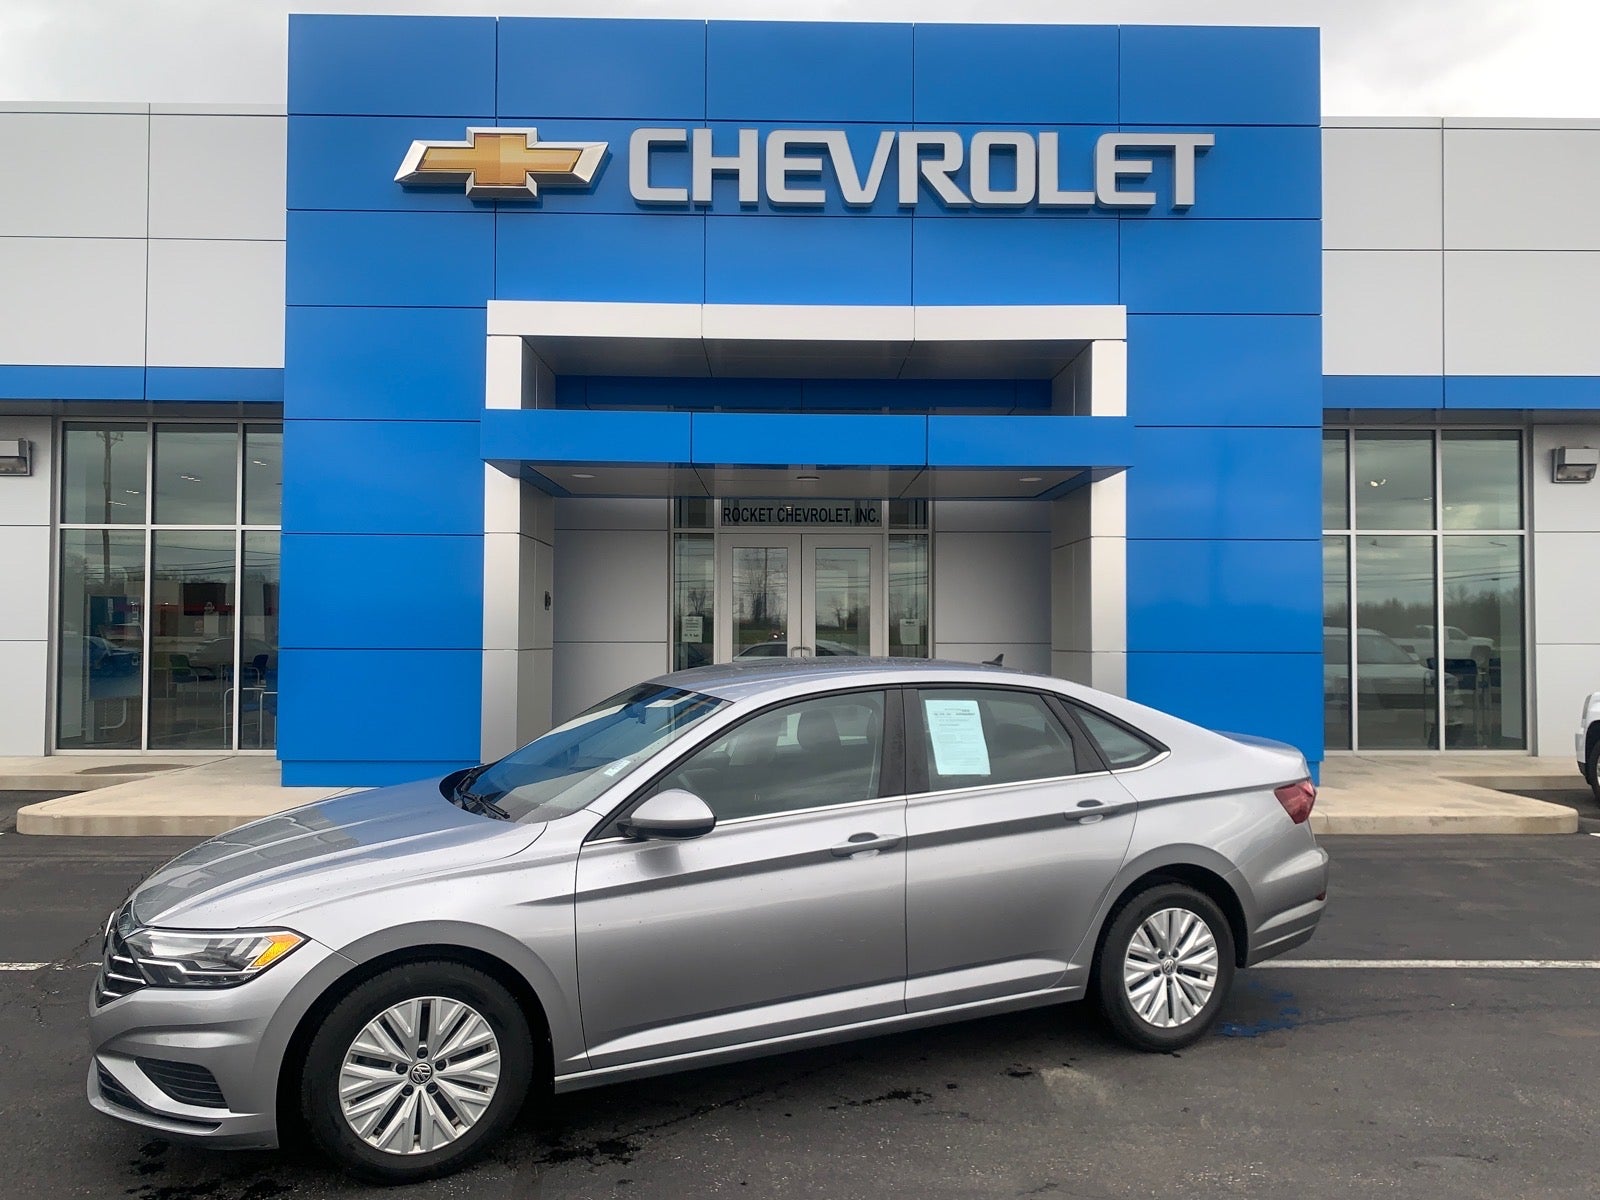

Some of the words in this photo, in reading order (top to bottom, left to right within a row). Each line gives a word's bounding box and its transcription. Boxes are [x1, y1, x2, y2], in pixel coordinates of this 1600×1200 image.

[628, 127, 1216, 210] CHEVROLET
[723, 507, 774, 523] ROCKET
[777, 507, 852, 525] CHEVROLET,
[856, 507, 880, 523] INC.
